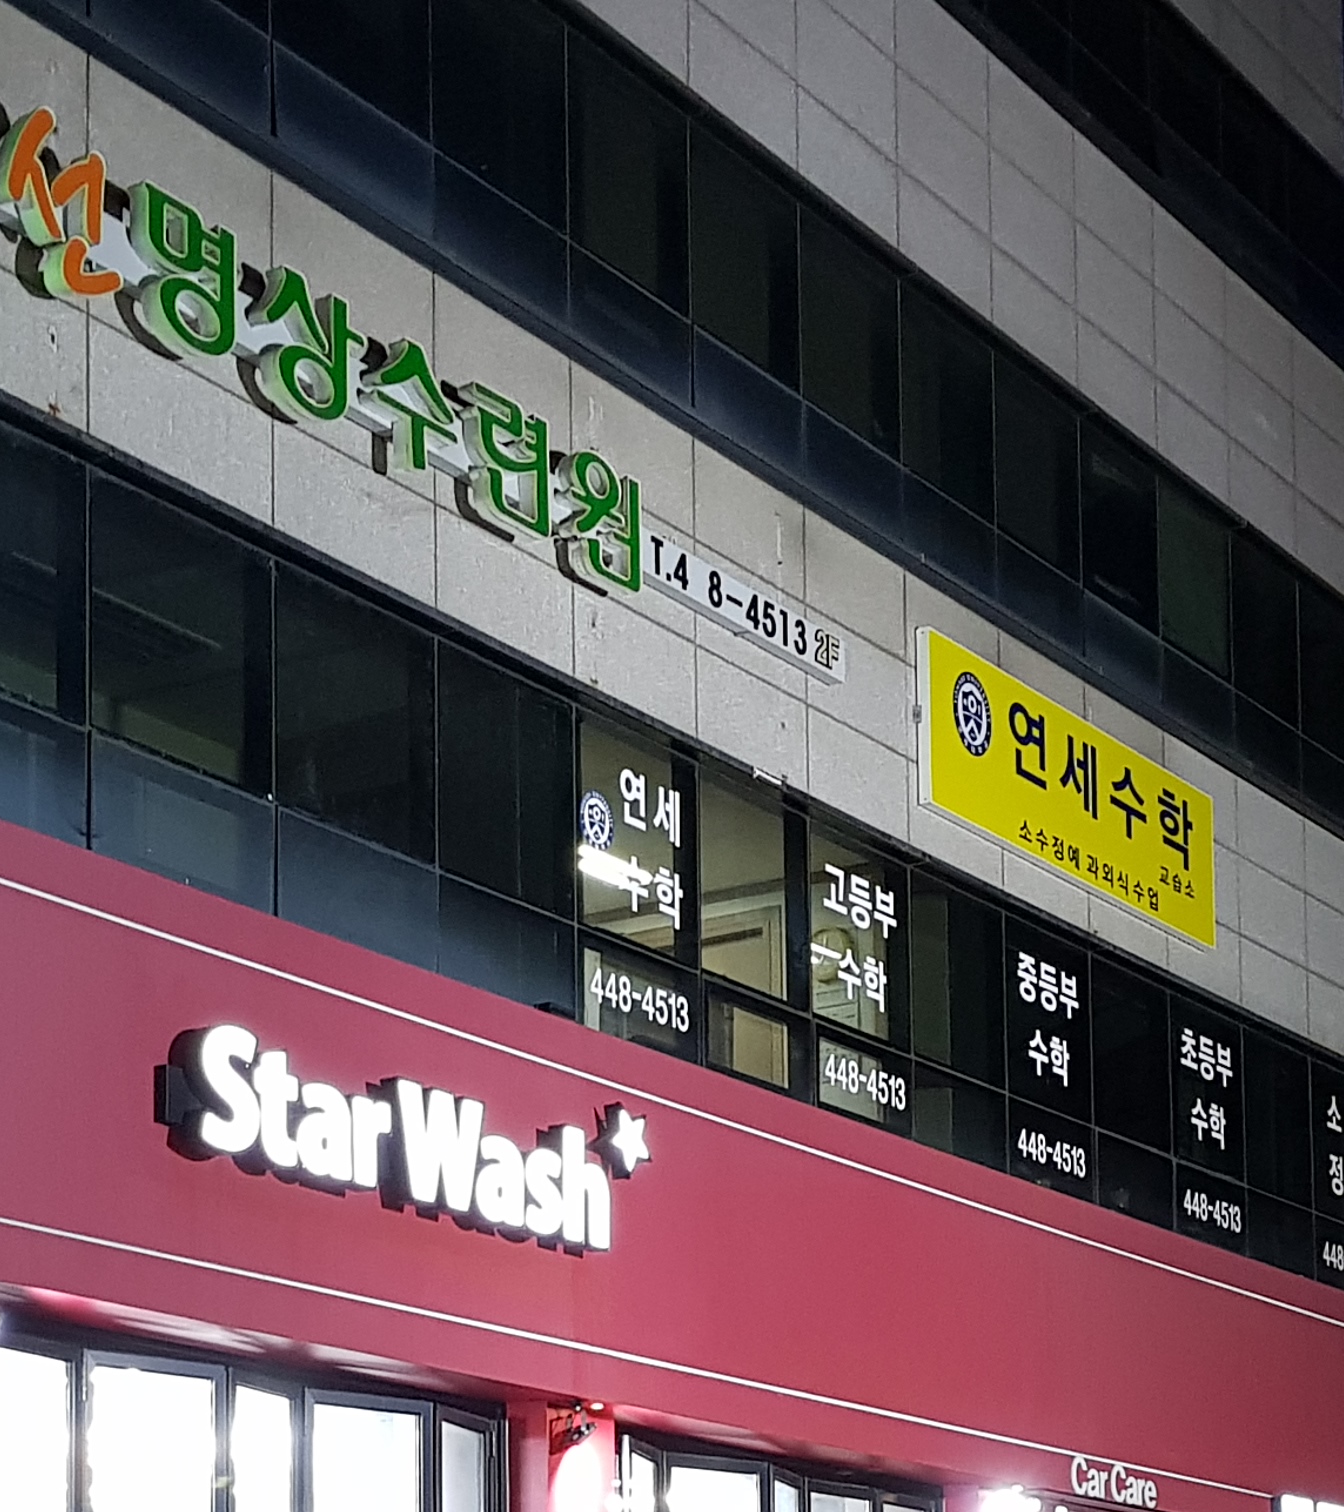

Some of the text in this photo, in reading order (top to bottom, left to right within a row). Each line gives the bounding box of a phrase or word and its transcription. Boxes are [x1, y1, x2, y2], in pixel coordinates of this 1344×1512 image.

[619, 767, 682, 849] 연세
[1008, 701, 1194, 872] 연세수학
[1018, 819, 1160, 912] 소수정예 과외식수업
[1158, 865, 1196, 899] 교습소
[822, 862, 898, 940] 고등부
[589, 967, 691, 1033] 448-4513
[837, 947, 888, 1014] 수학
[1016, 951, 1080, 1020] 중등부
[824, 1053, 907, 1112] 448-4513
[1027, 1029, 1071, 1088] 수학
[1179, 1027, 1234, 1088] 초등부
[199, 1023, 613, 1253] Star Wash
[1017, 1127, 1087, 1179] 448-4513
[1189, 1097, 1227, 1151] 수학
[1182, 1188, 1243, 1234] 448-4513
[1069, 1455, 1158, 1509] Car Care
